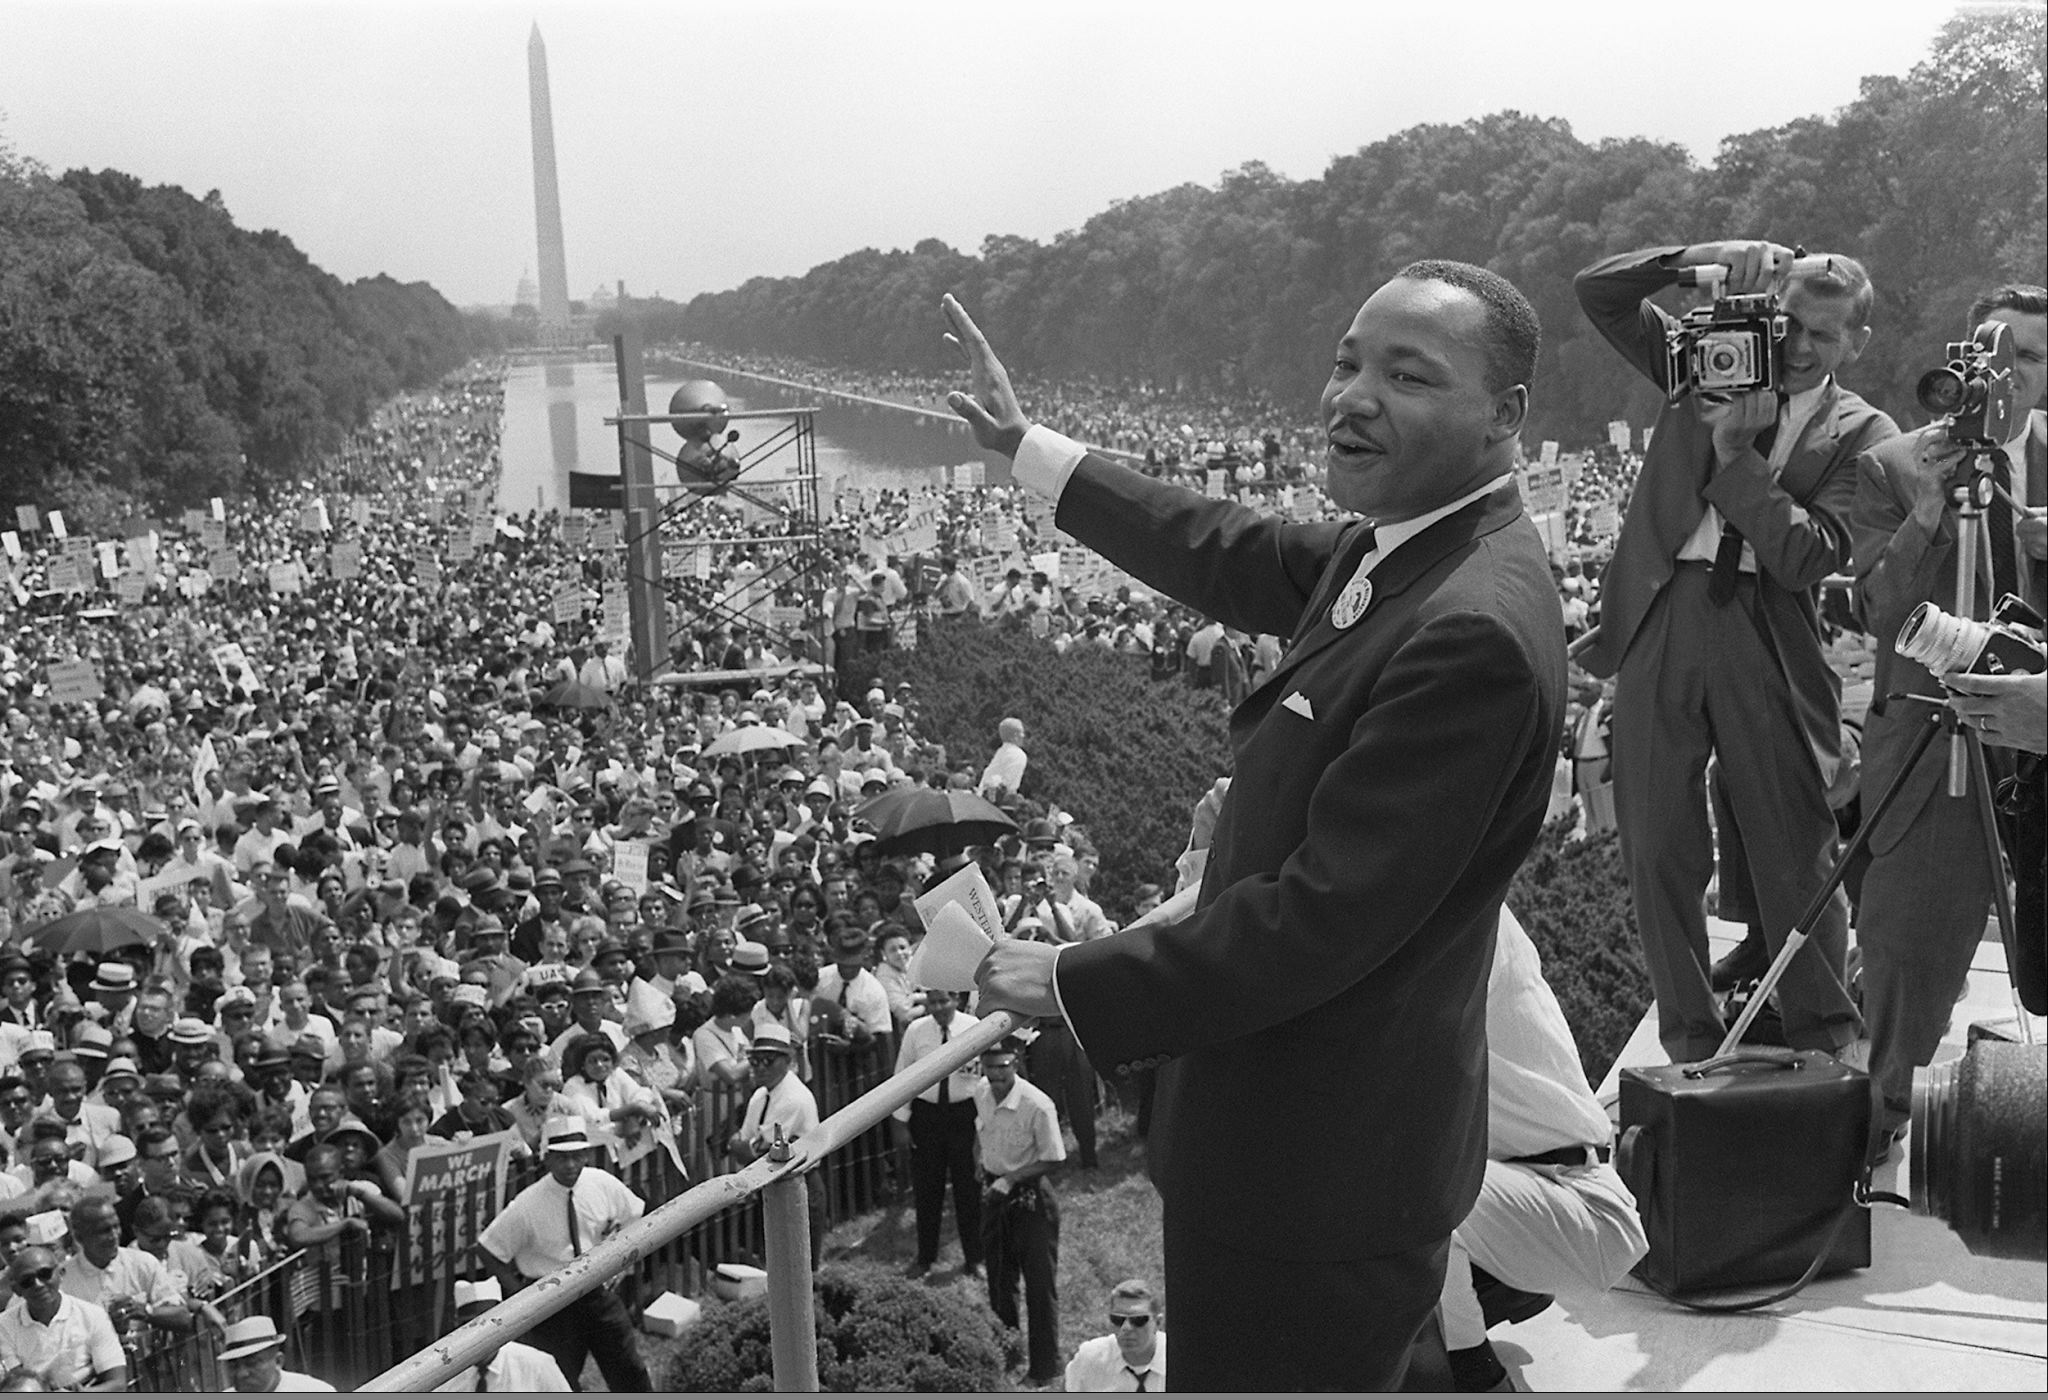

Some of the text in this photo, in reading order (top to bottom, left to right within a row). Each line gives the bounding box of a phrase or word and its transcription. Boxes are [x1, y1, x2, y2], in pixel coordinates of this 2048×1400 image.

[968, 887, 997, 942] WESTERN
[418, 1161, 492, 1193] MARCH
[447, 1152, 473, 1171] WE
